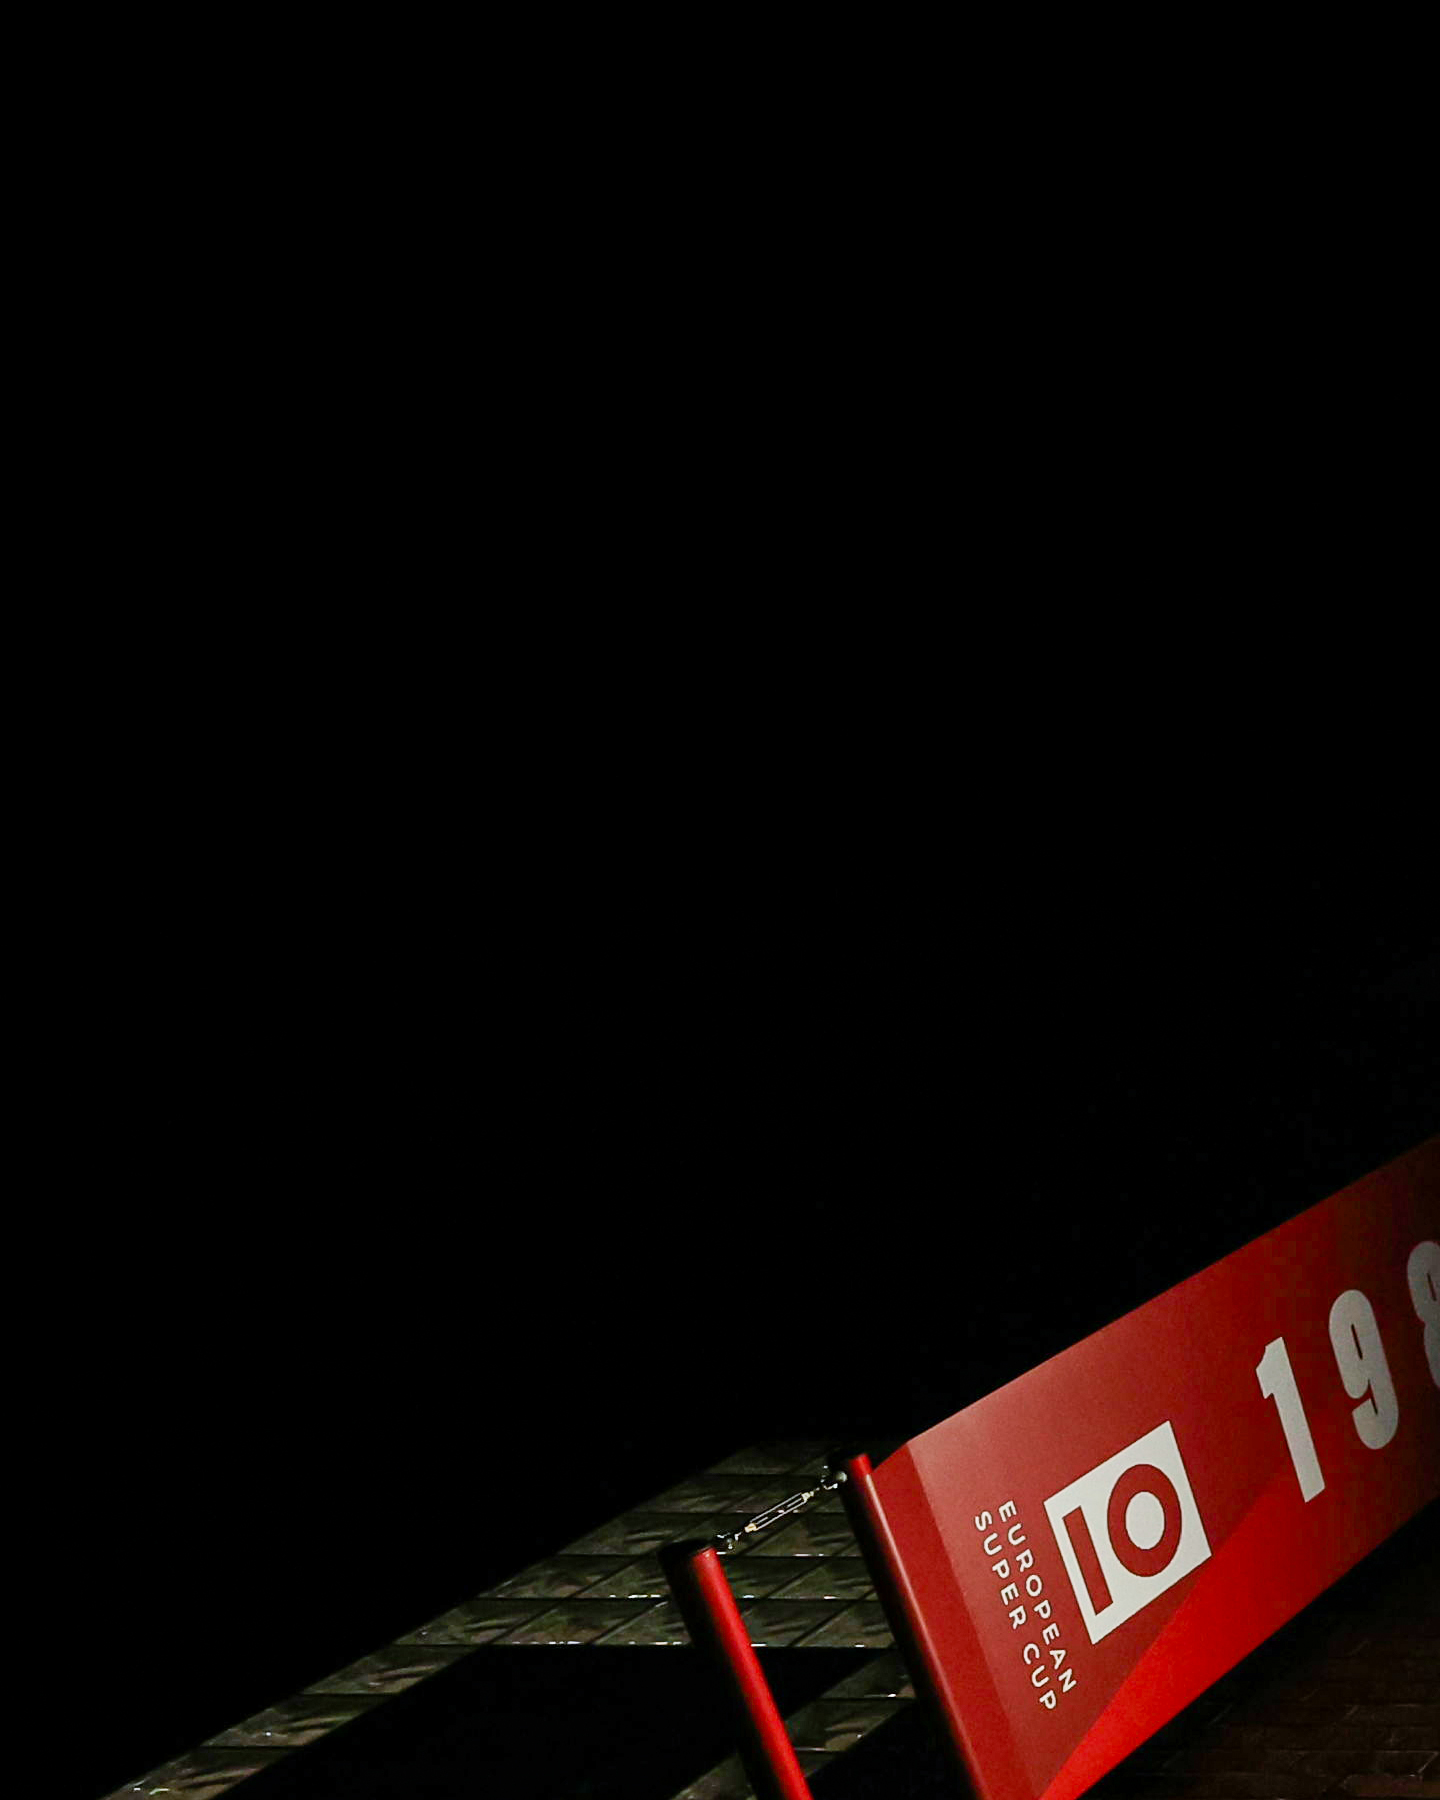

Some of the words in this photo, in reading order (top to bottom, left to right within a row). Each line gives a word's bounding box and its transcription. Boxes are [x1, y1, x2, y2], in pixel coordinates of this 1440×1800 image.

[974, 1510, 1027, 1630] SUPER
[1023, 1643, 1057, 1709] CUP
[998, 1500, 1077, 1693] EUROPEAN
